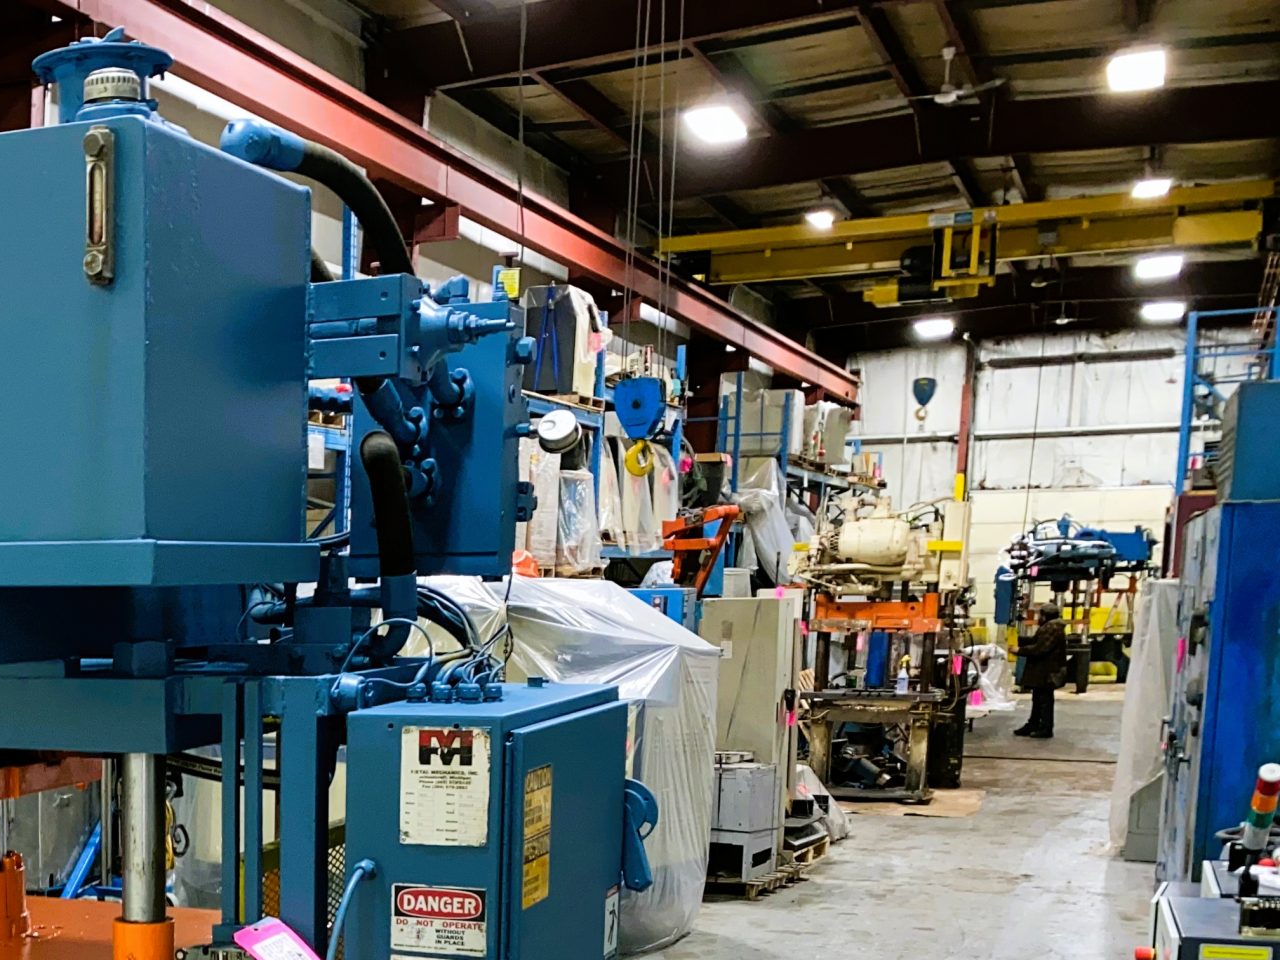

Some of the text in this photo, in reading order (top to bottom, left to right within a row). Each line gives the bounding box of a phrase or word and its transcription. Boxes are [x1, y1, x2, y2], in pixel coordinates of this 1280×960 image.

[403, 894, 476, 915] DANGER
[396, 918, 484, 930] DO NOT OPERATE
